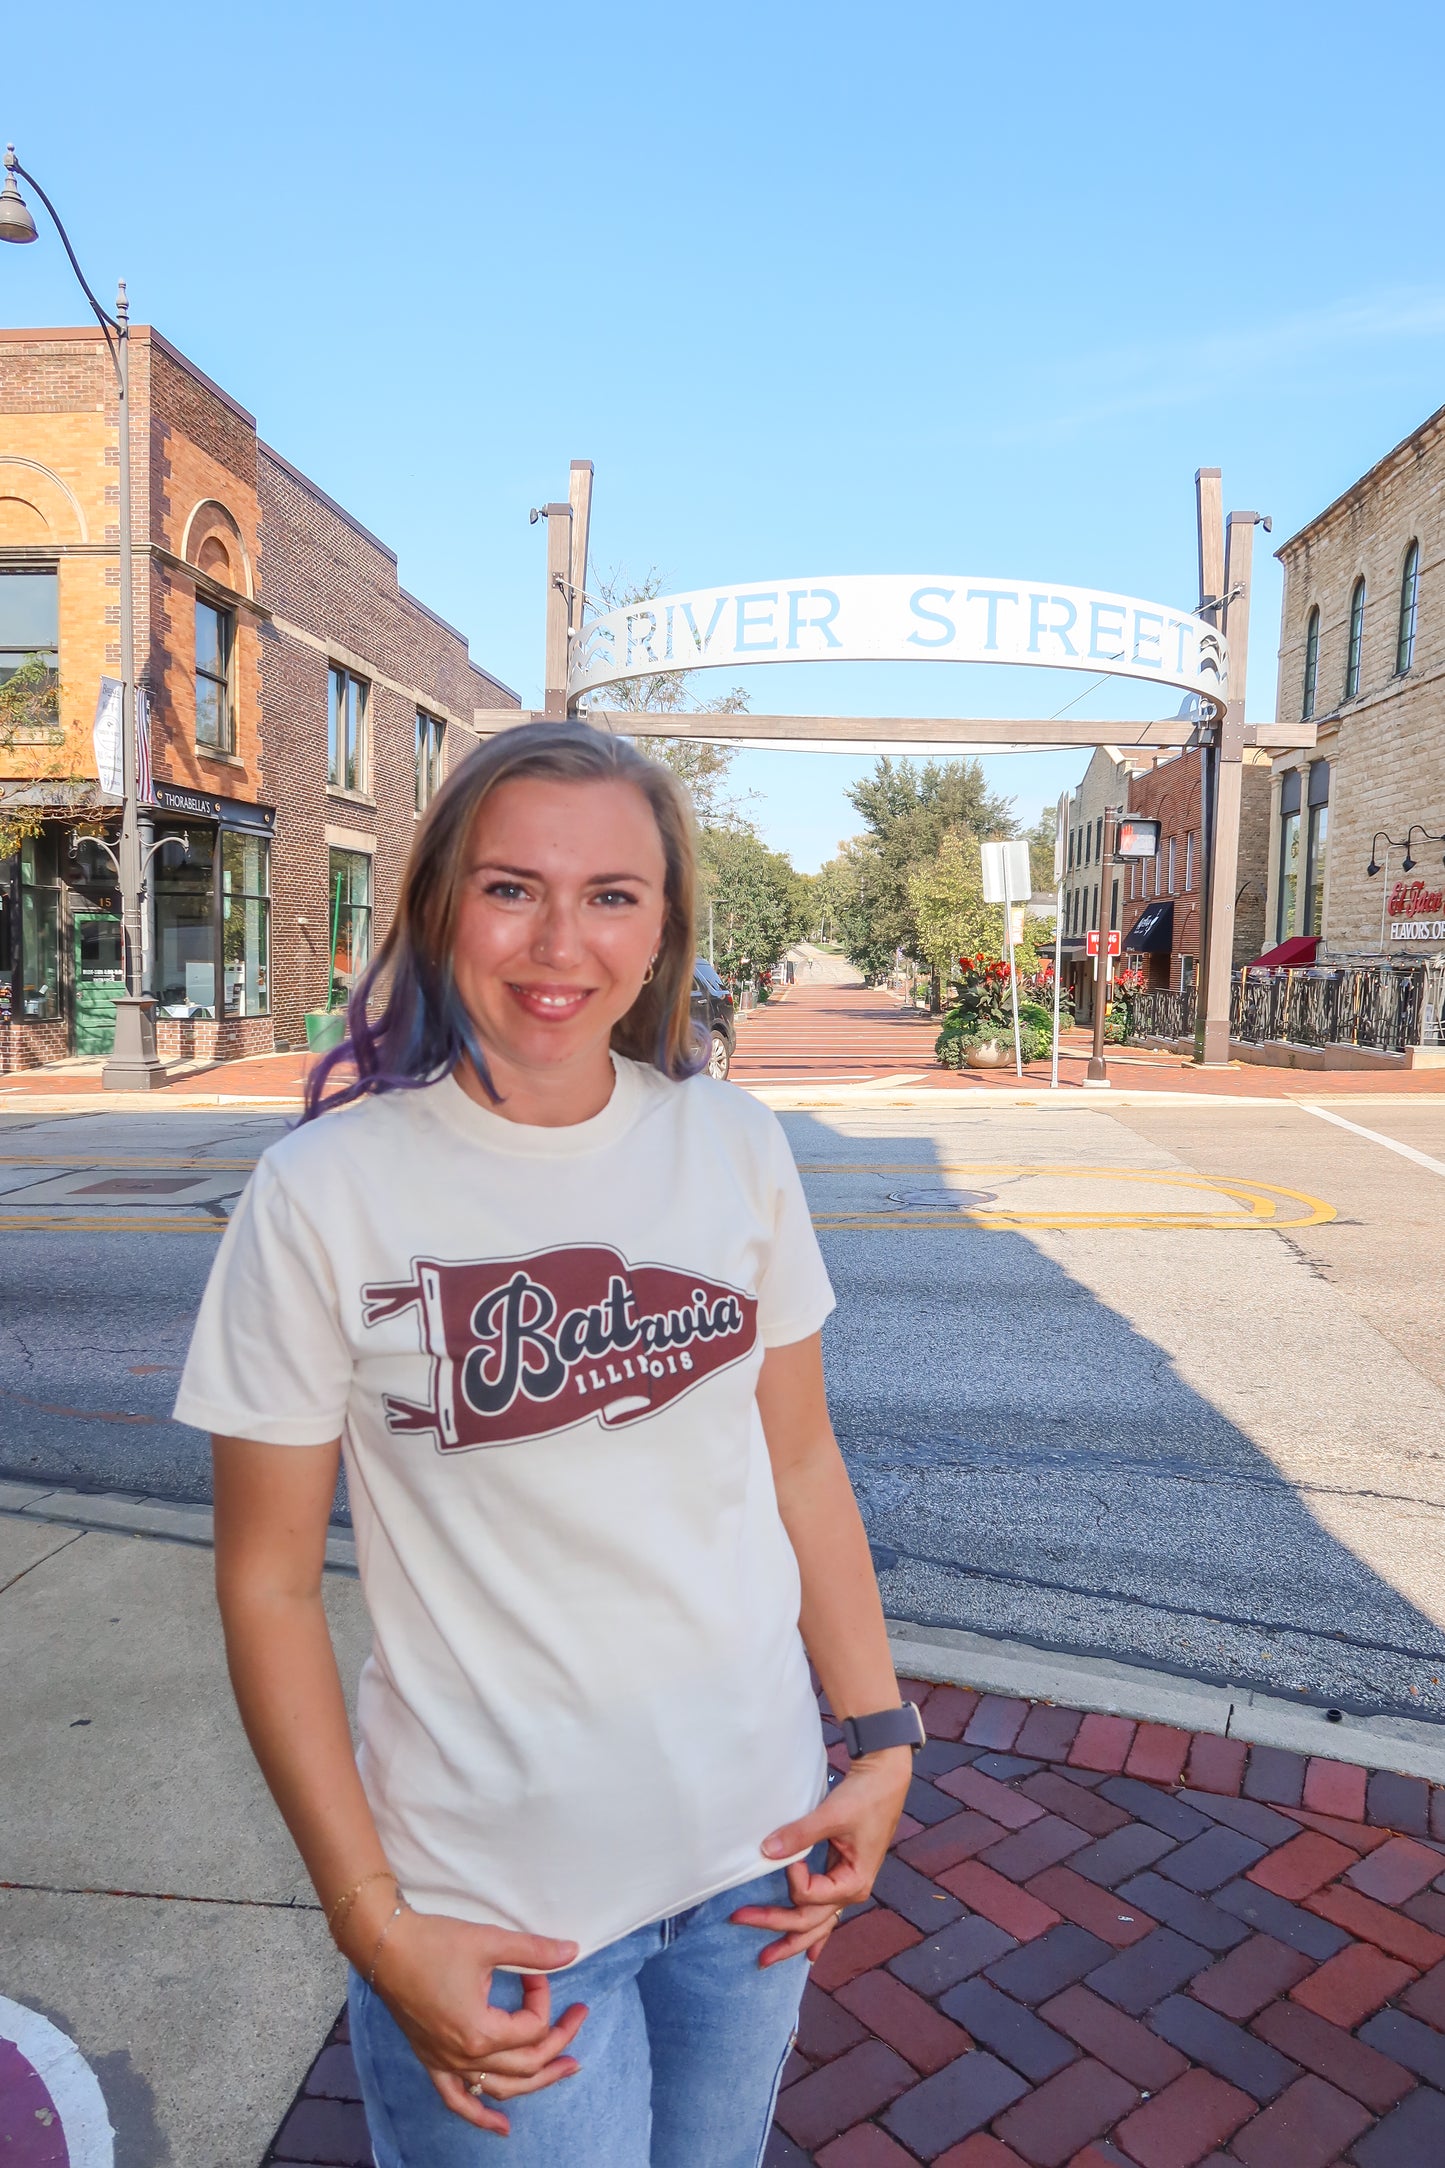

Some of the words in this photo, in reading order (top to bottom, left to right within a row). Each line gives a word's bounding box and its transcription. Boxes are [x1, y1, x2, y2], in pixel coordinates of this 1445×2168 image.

[625, 588, 843, 667] RIVER
[906, 586, 1194, 674] STREET
[164, 793, 211, 814] THORABELLA'S
[99, 897, 112, 908] 15
[1091, 934, 1117, 943] WNG
[1390, 921, 1430, 940] FLAVORS
[462, 1271, 742, 1416] Batavia
